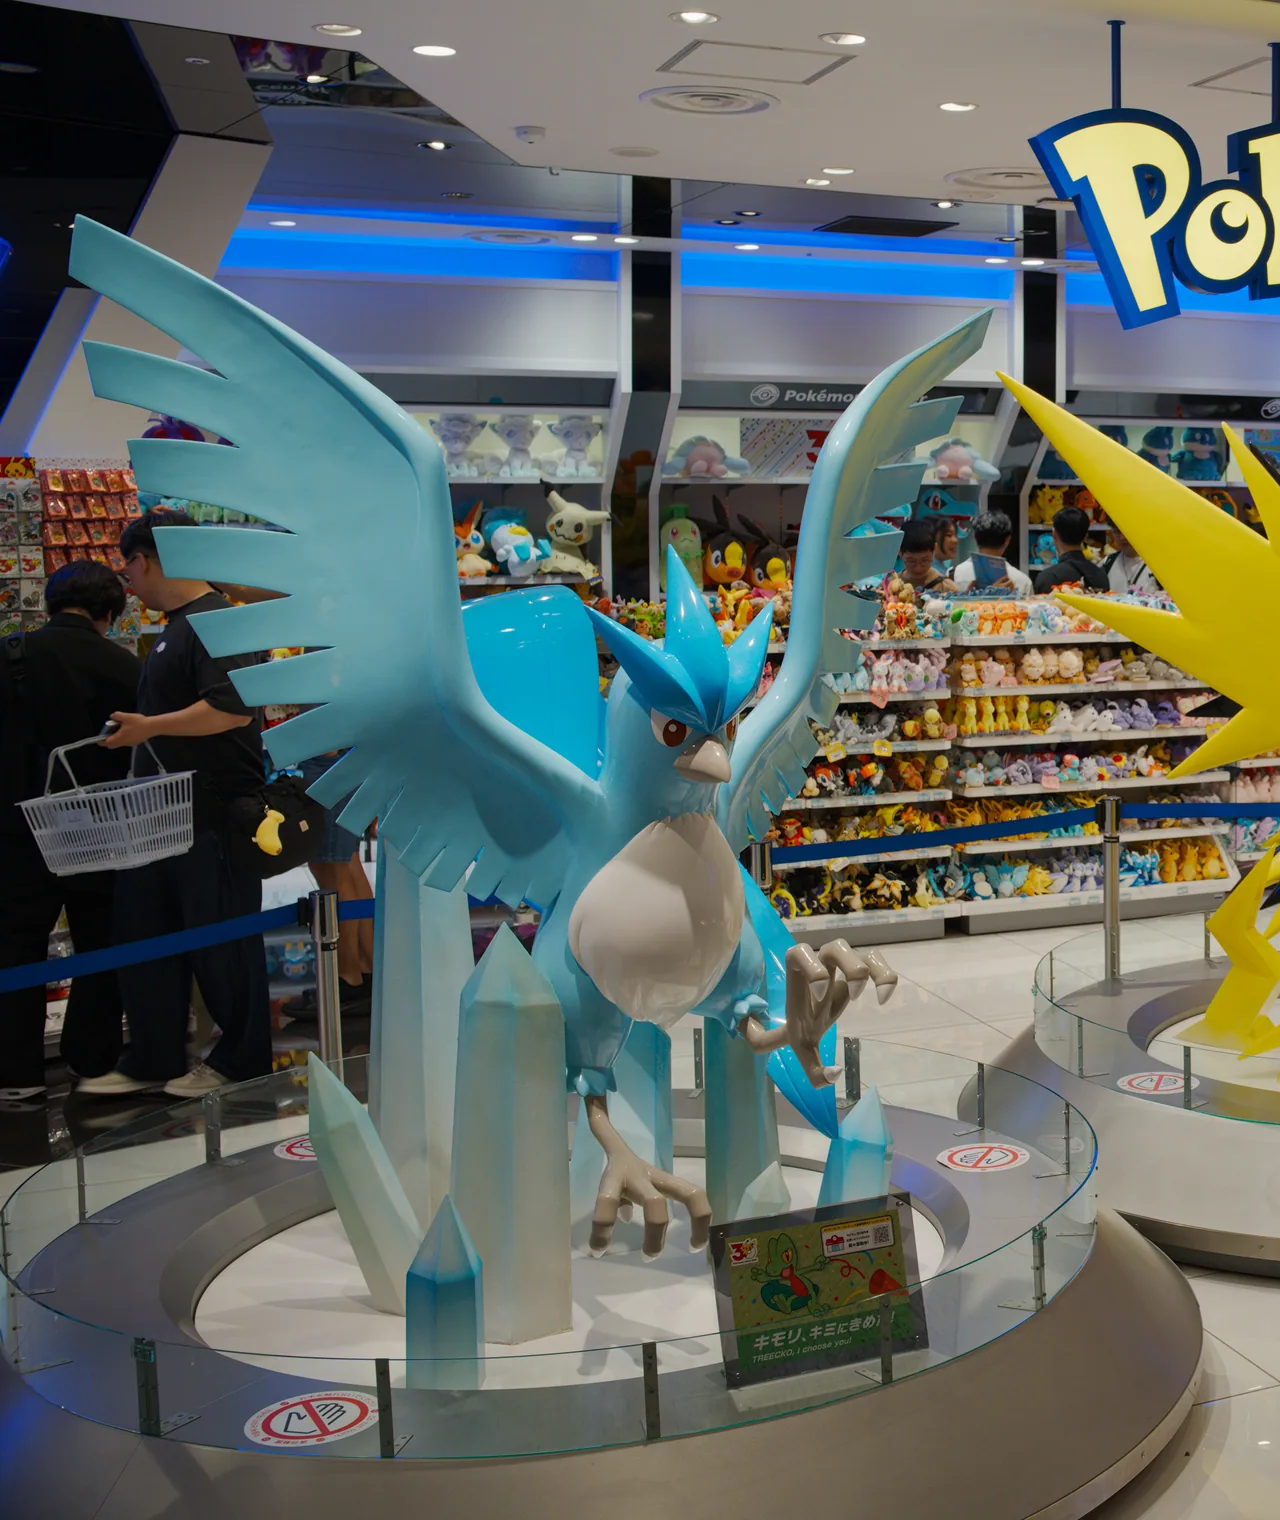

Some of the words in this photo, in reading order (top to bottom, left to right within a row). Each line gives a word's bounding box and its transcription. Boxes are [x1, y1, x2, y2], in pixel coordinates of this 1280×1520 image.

[752, 1348, 795, 1364] TREECKO,
[802, 1341, 833, 1354] choose
[833, 1336, 853, 1349] you!
